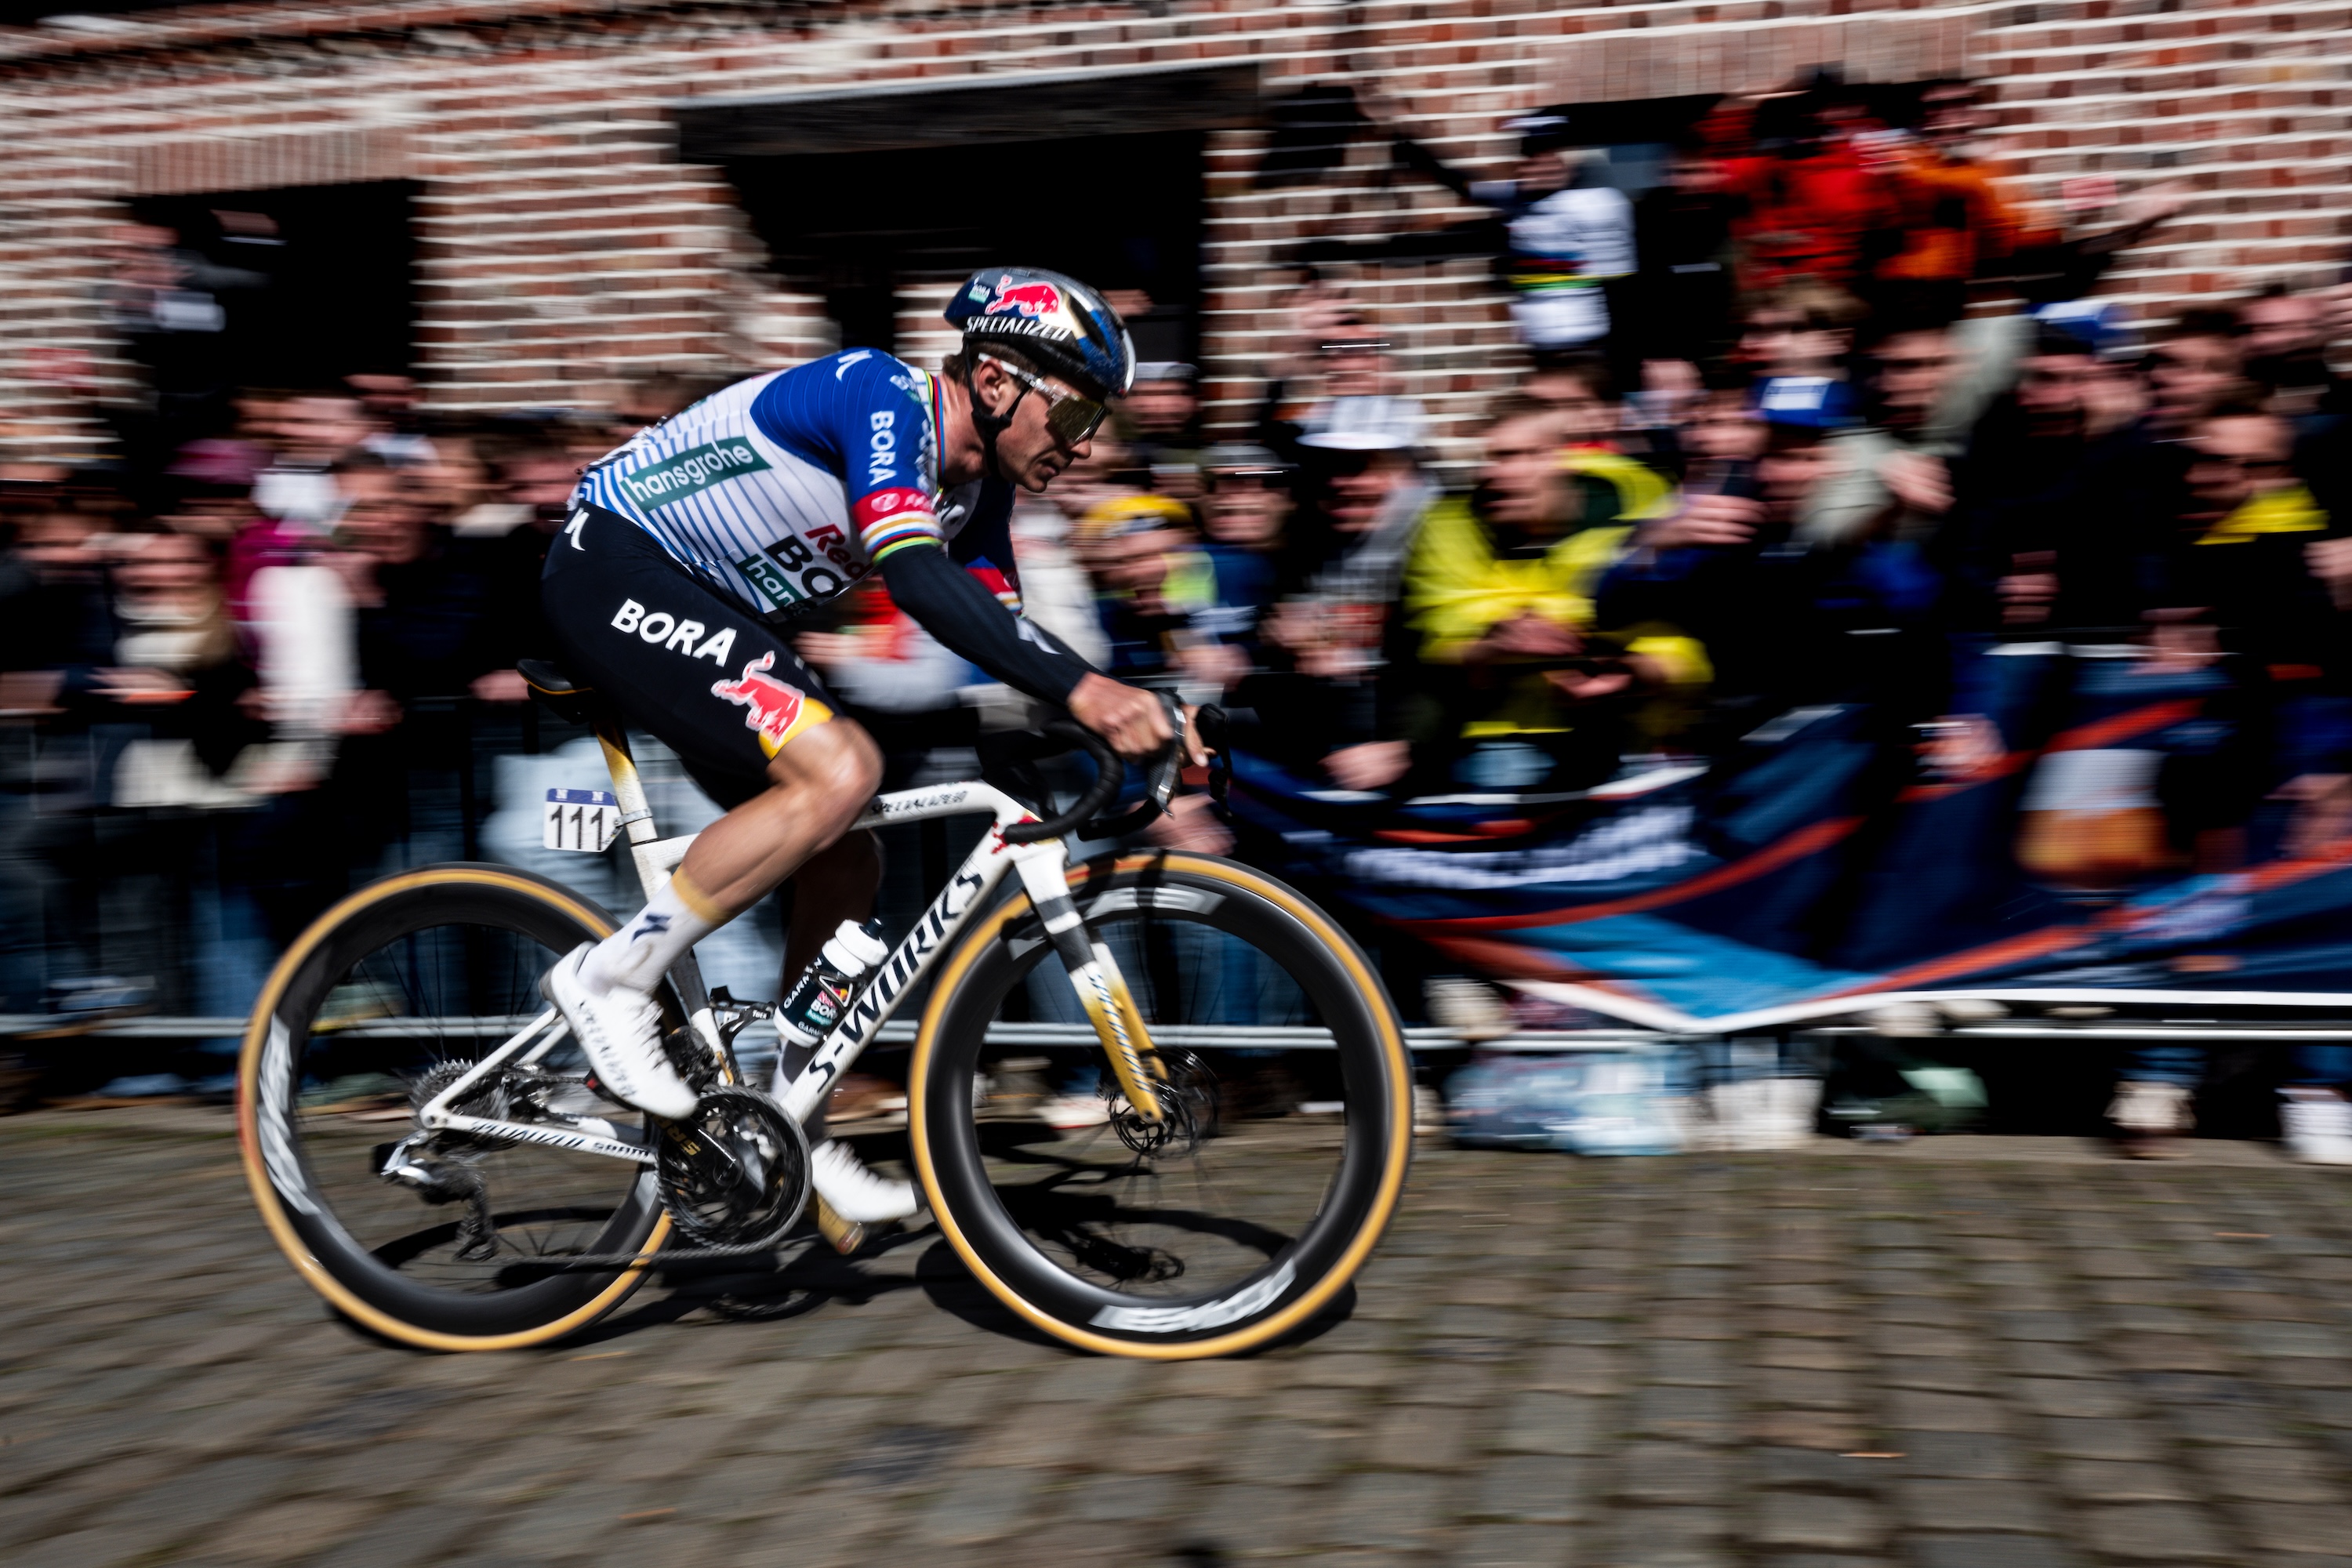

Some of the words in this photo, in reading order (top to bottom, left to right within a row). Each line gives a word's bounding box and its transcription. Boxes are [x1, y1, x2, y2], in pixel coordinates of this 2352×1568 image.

[964, 316, 1073, 341] SPECIALIZED
[627, 441, 754, 503] hansgrohe
[869, 410, 898, 487] BORA
[804, 523, 870, 580] Red
[611, 598, 737, 666] BORA
[550, 804, 604, 851] 111
[810, 872, 983, 1093] S-WORKS
[592, 1142, 649, 1158] SRAM
[654, 1115, 702, 1157] SRA
